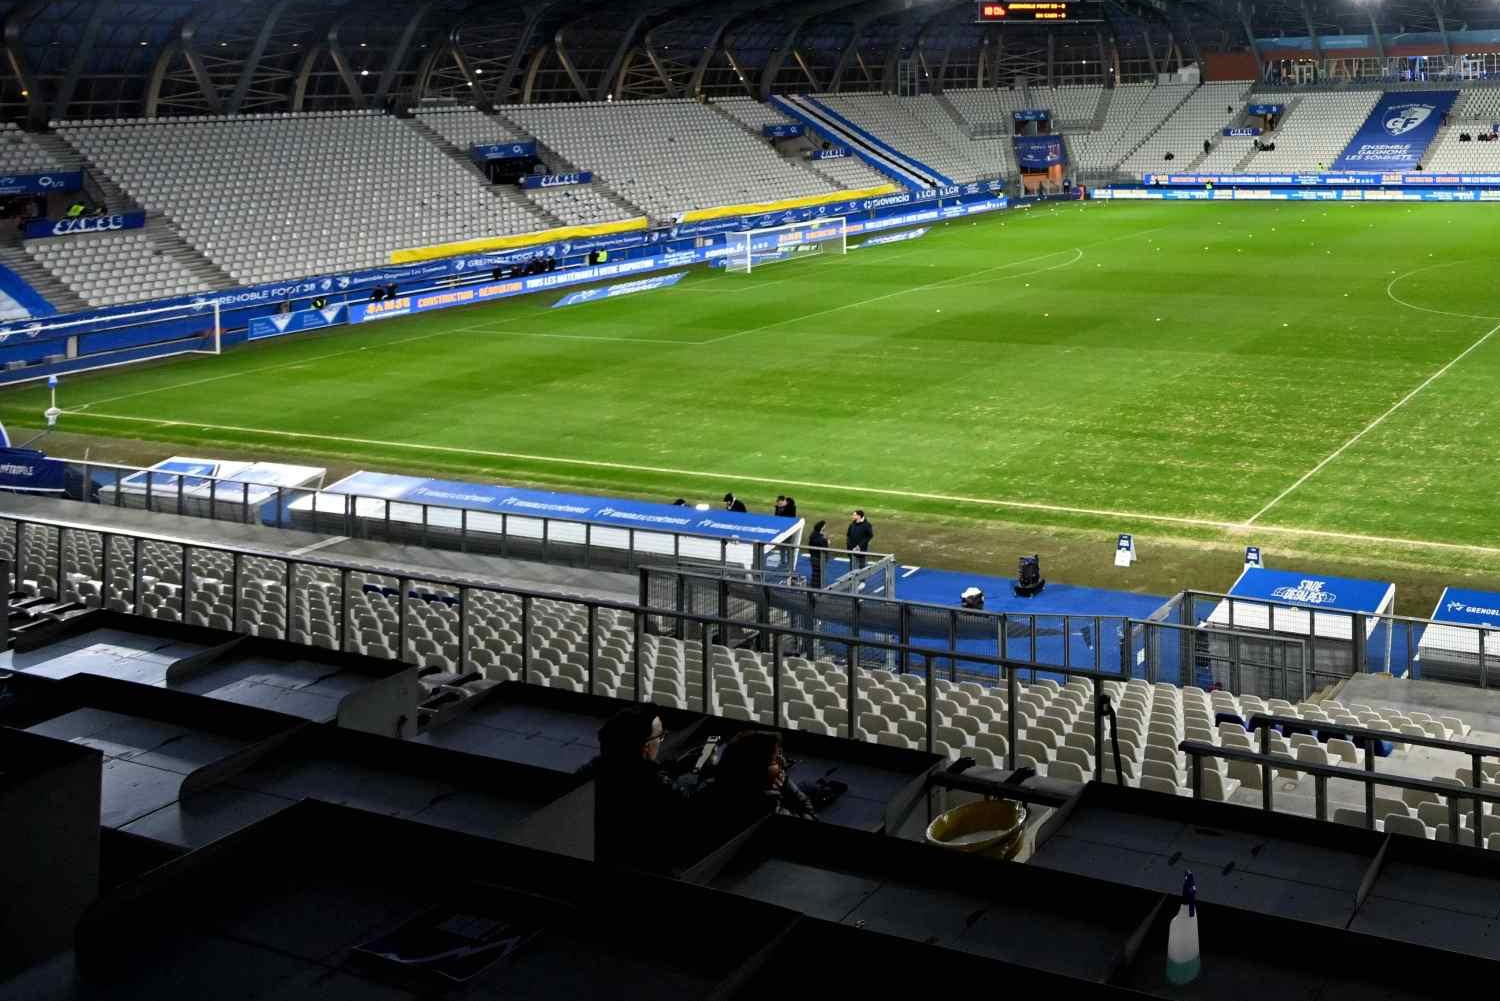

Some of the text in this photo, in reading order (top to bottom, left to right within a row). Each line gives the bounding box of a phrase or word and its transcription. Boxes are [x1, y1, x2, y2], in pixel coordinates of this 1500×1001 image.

[52, 214, 123, 236] SAMSE
[271, 284, 300, 297] FOOT
[303, 282, 316, 292] 38
